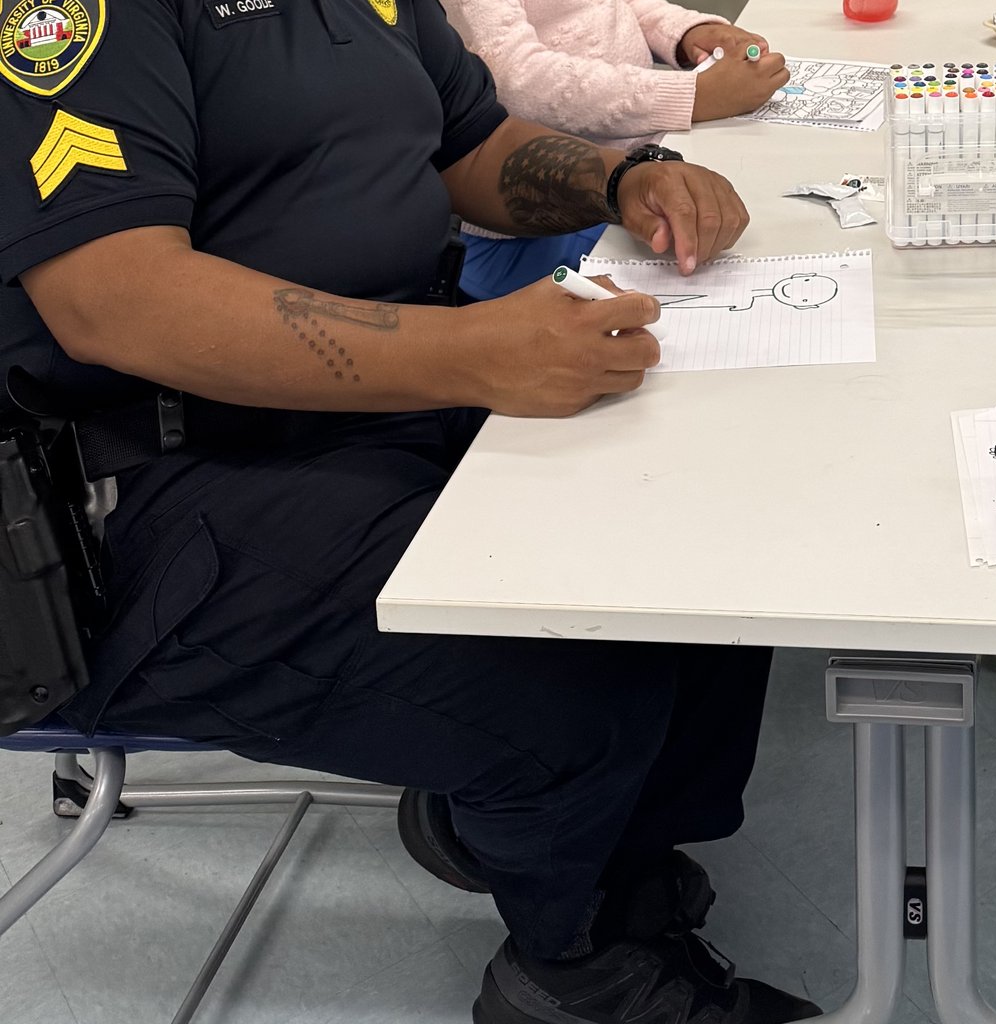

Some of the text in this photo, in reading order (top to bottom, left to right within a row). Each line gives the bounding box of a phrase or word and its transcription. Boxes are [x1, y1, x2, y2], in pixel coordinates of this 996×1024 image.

[215, 3, 236, 18] W.
[34, 58, 59, 73] 1819
[909, 902, 922, 923] VS
